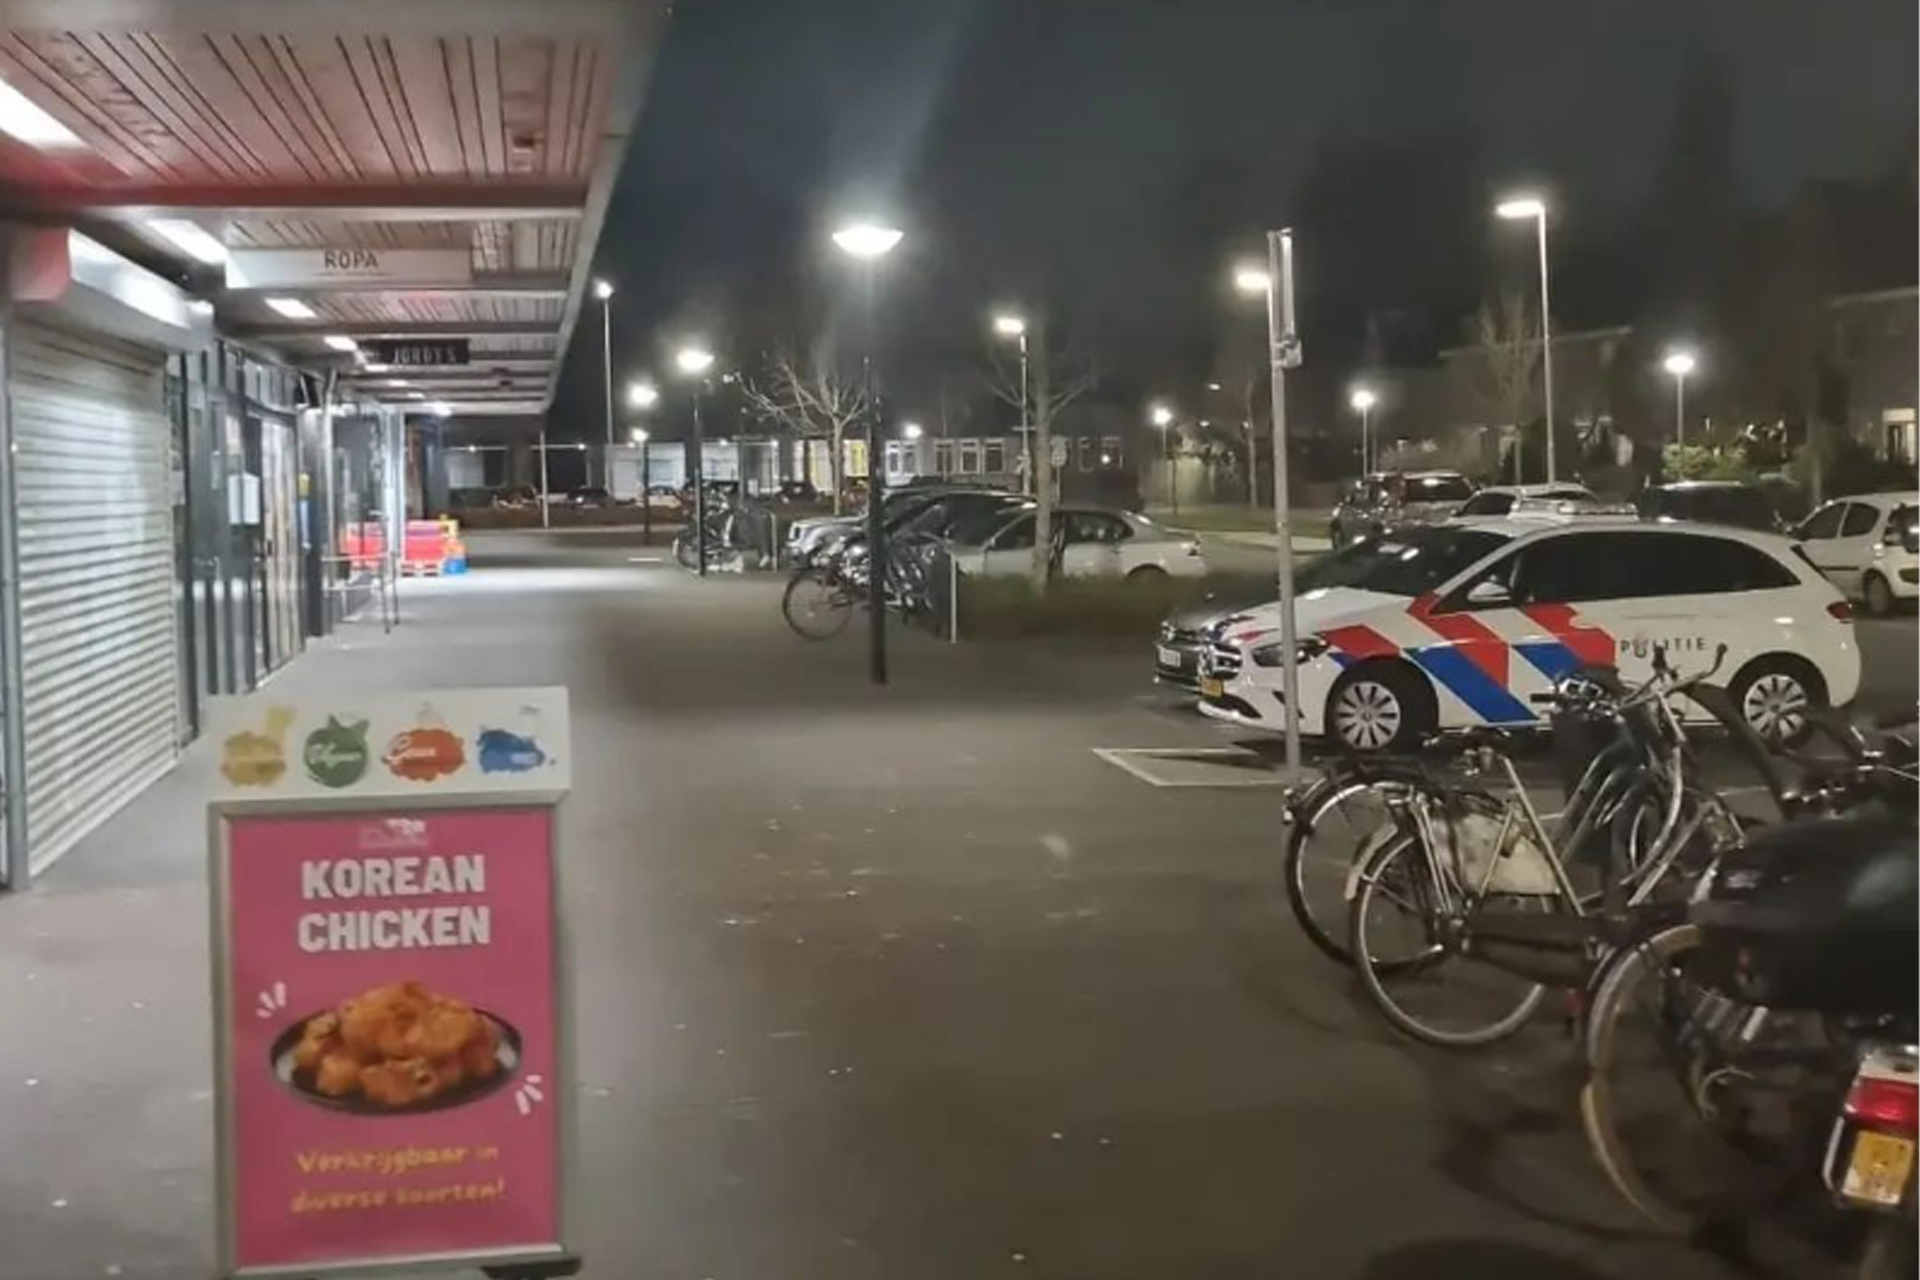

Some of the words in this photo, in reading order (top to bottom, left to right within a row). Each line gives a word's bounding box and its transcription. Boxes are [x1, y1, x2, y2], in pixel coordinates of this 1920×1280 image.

[324, 250, 379, 269] ROPA
[302, 854, 486, 899] KOREAN
[298, 906, 491, 951] CHICKEN
